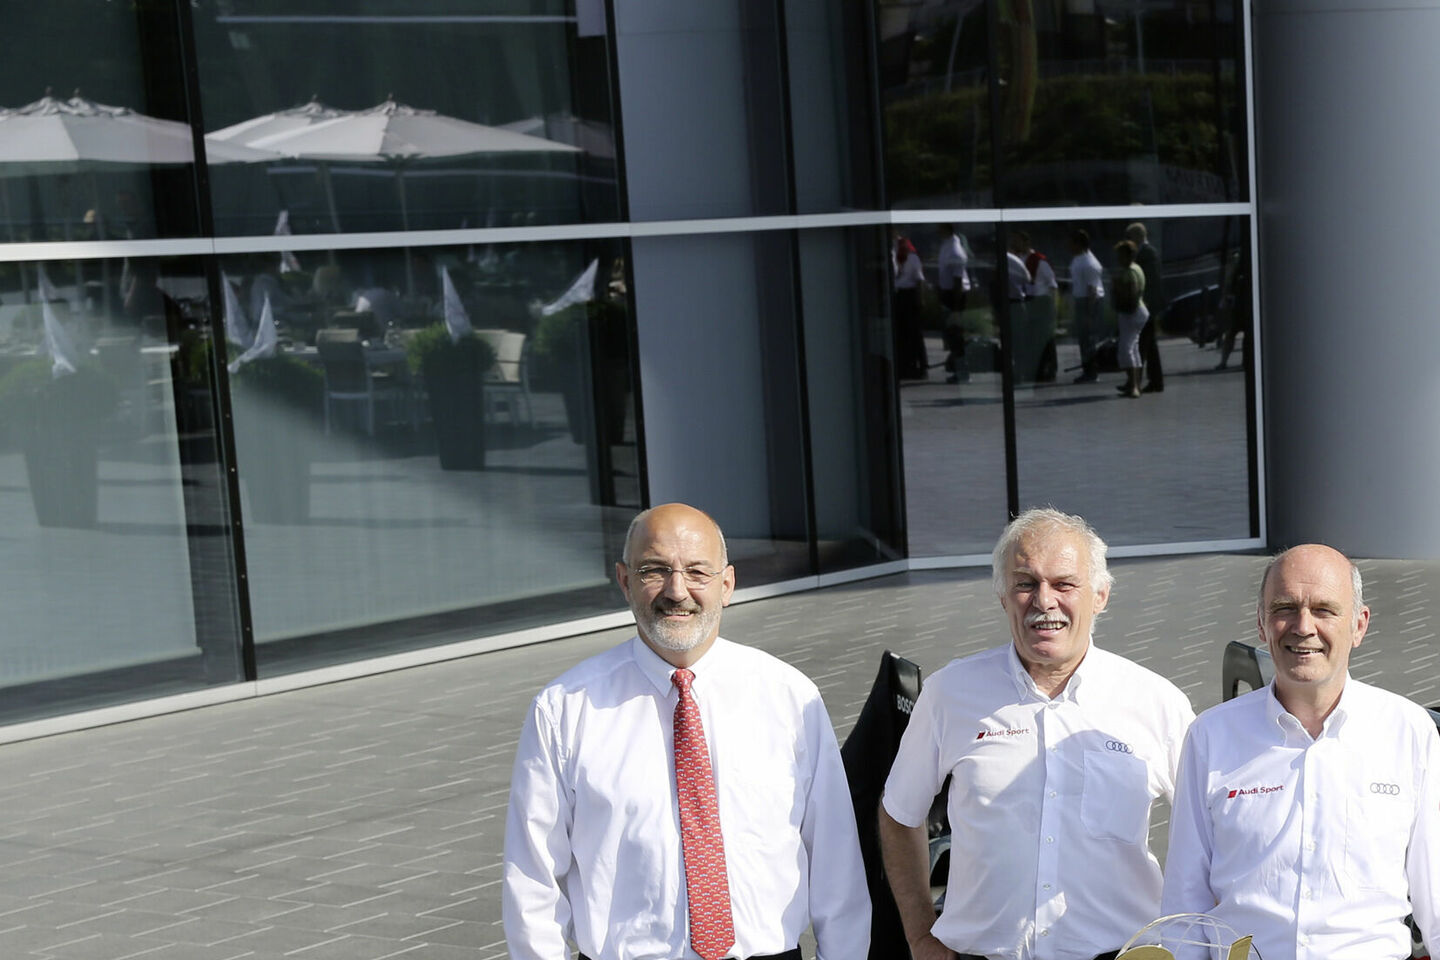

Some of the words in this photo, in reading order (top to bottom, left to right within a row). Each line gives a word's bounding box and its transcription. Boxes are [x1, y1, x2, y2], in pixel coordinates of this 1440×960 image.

[1006, 728, 1030, 736] Sport
[1239, 787, 1259, 795] Audi
[1260, 785, 1285, 794] Sport
